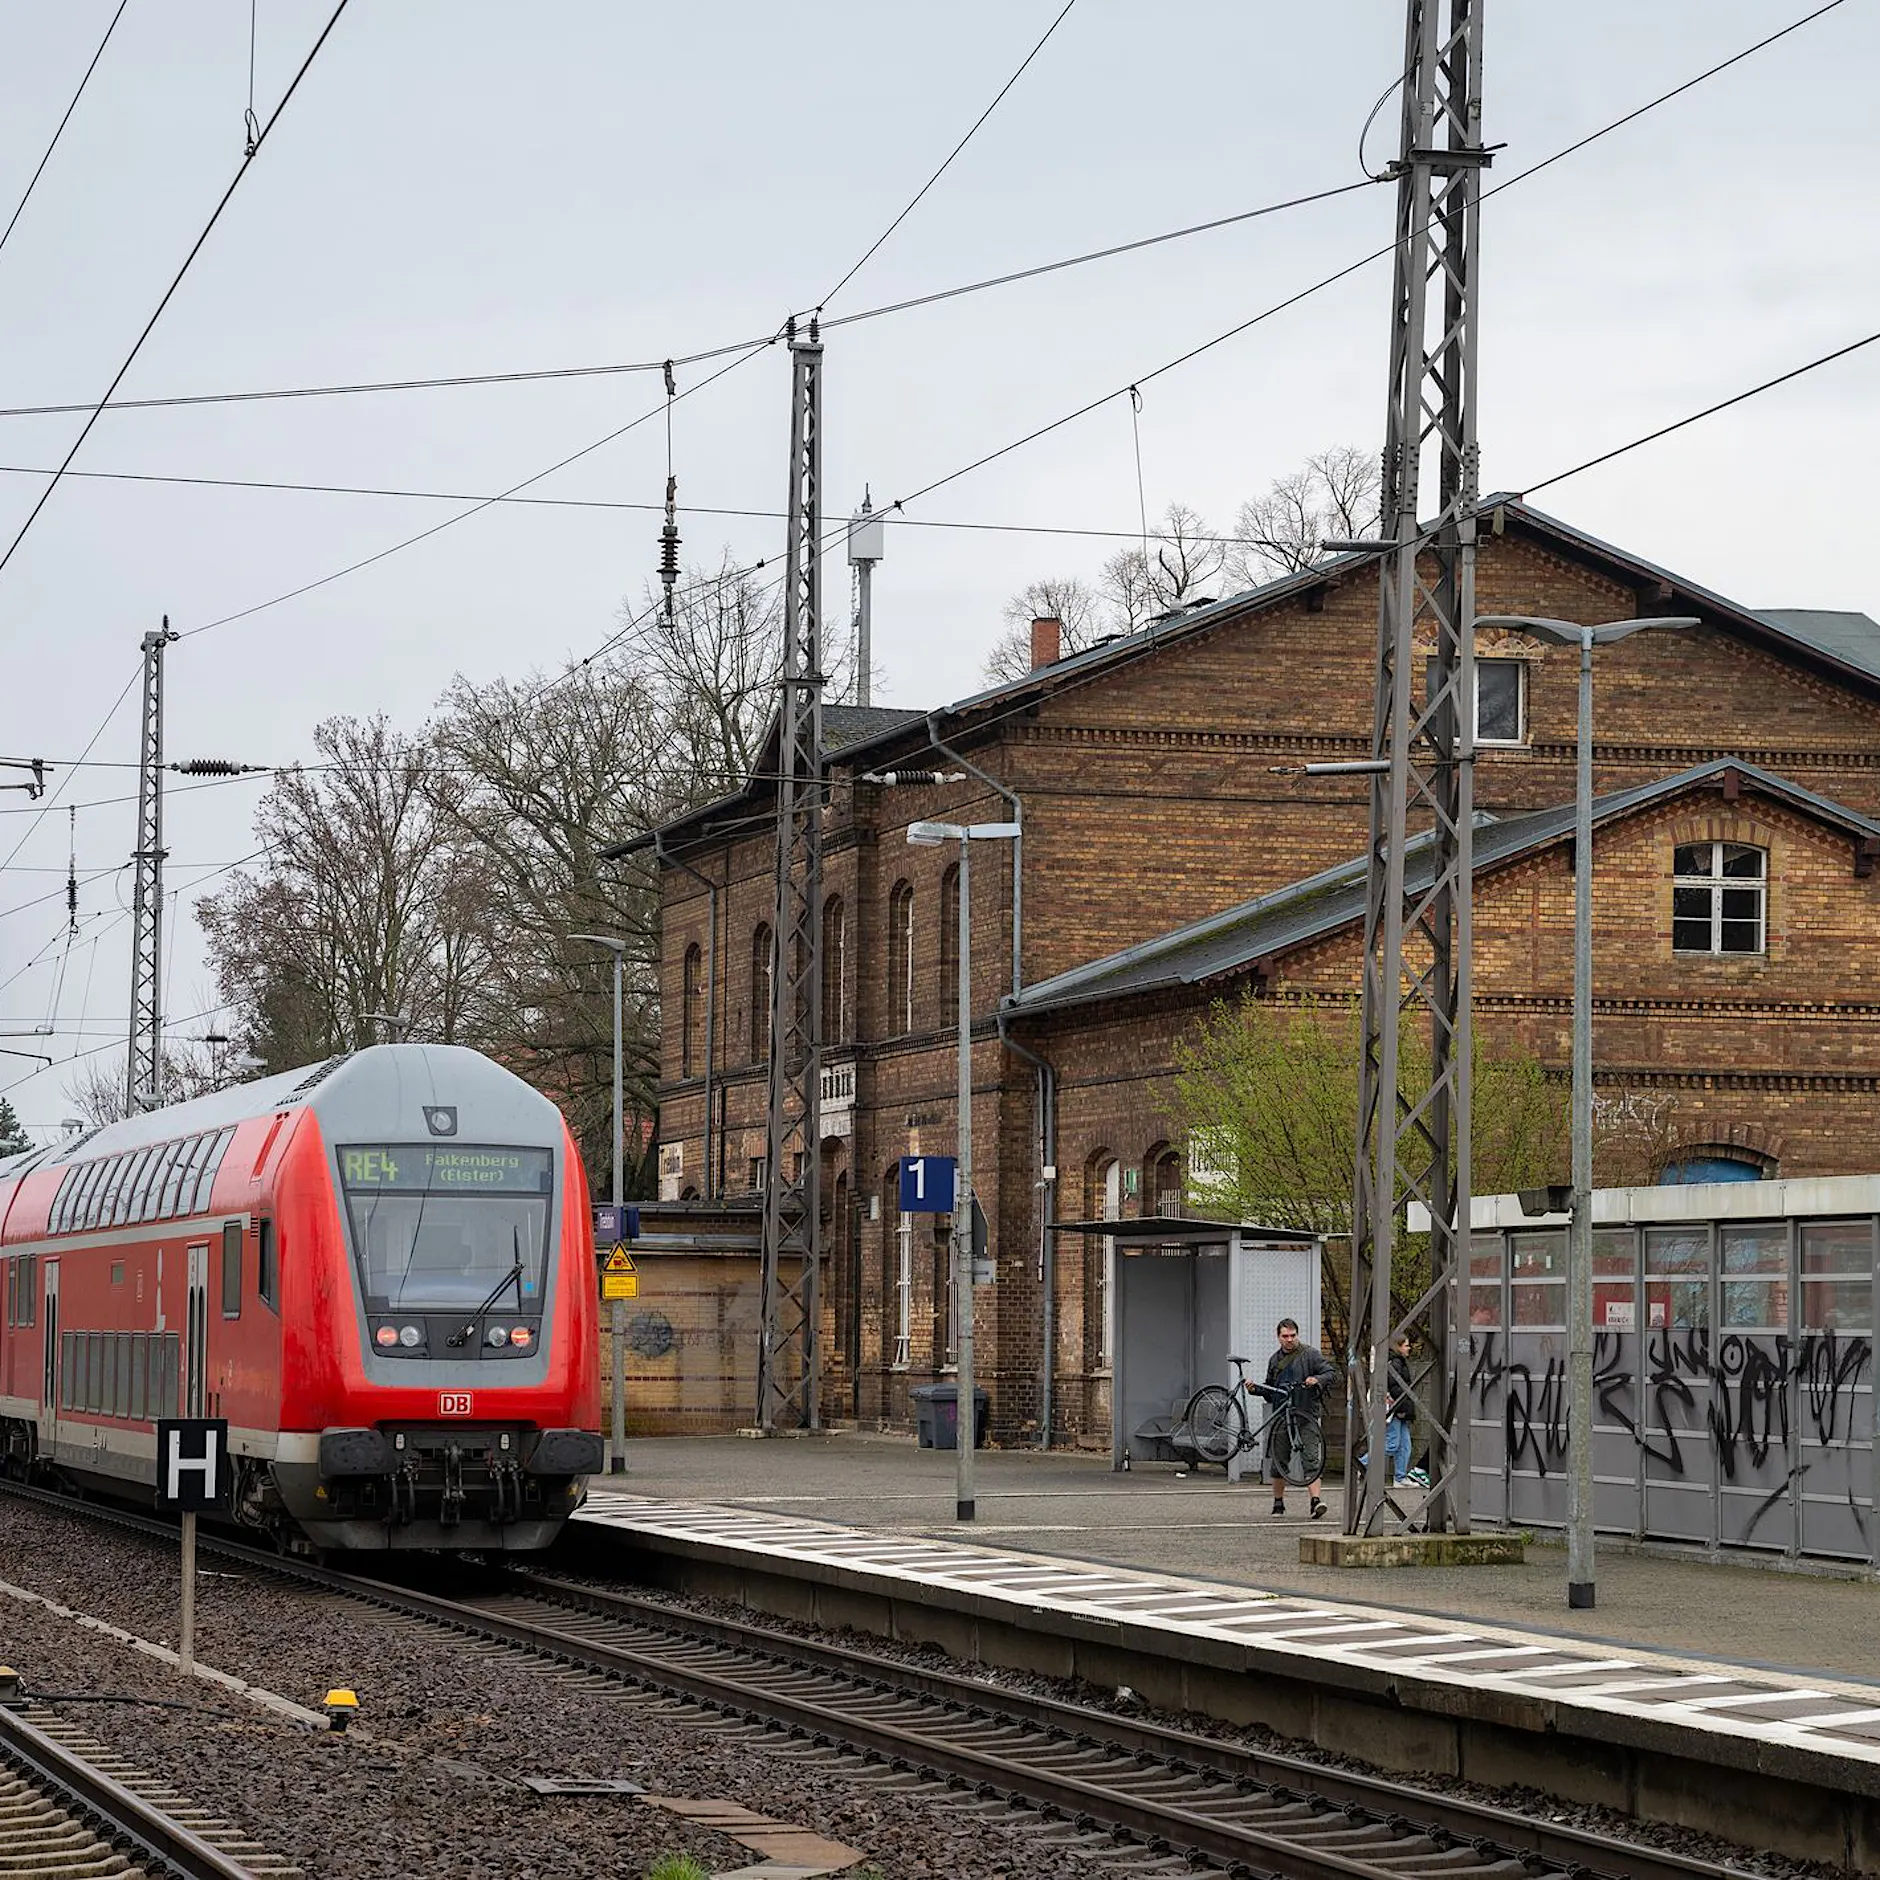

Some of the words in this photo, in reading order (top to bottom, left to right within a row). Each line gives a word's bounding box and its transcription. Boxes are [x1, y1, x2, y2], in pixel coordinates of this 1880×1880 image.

[345, 1151, 398, 1182] RE4
[425, 1154, 519, 1168] Falkenberg
[908, 1159, 925, 1199] 1
[442, 1395, 469, 1412] DB
[168, 1430, 217, 1499] H
